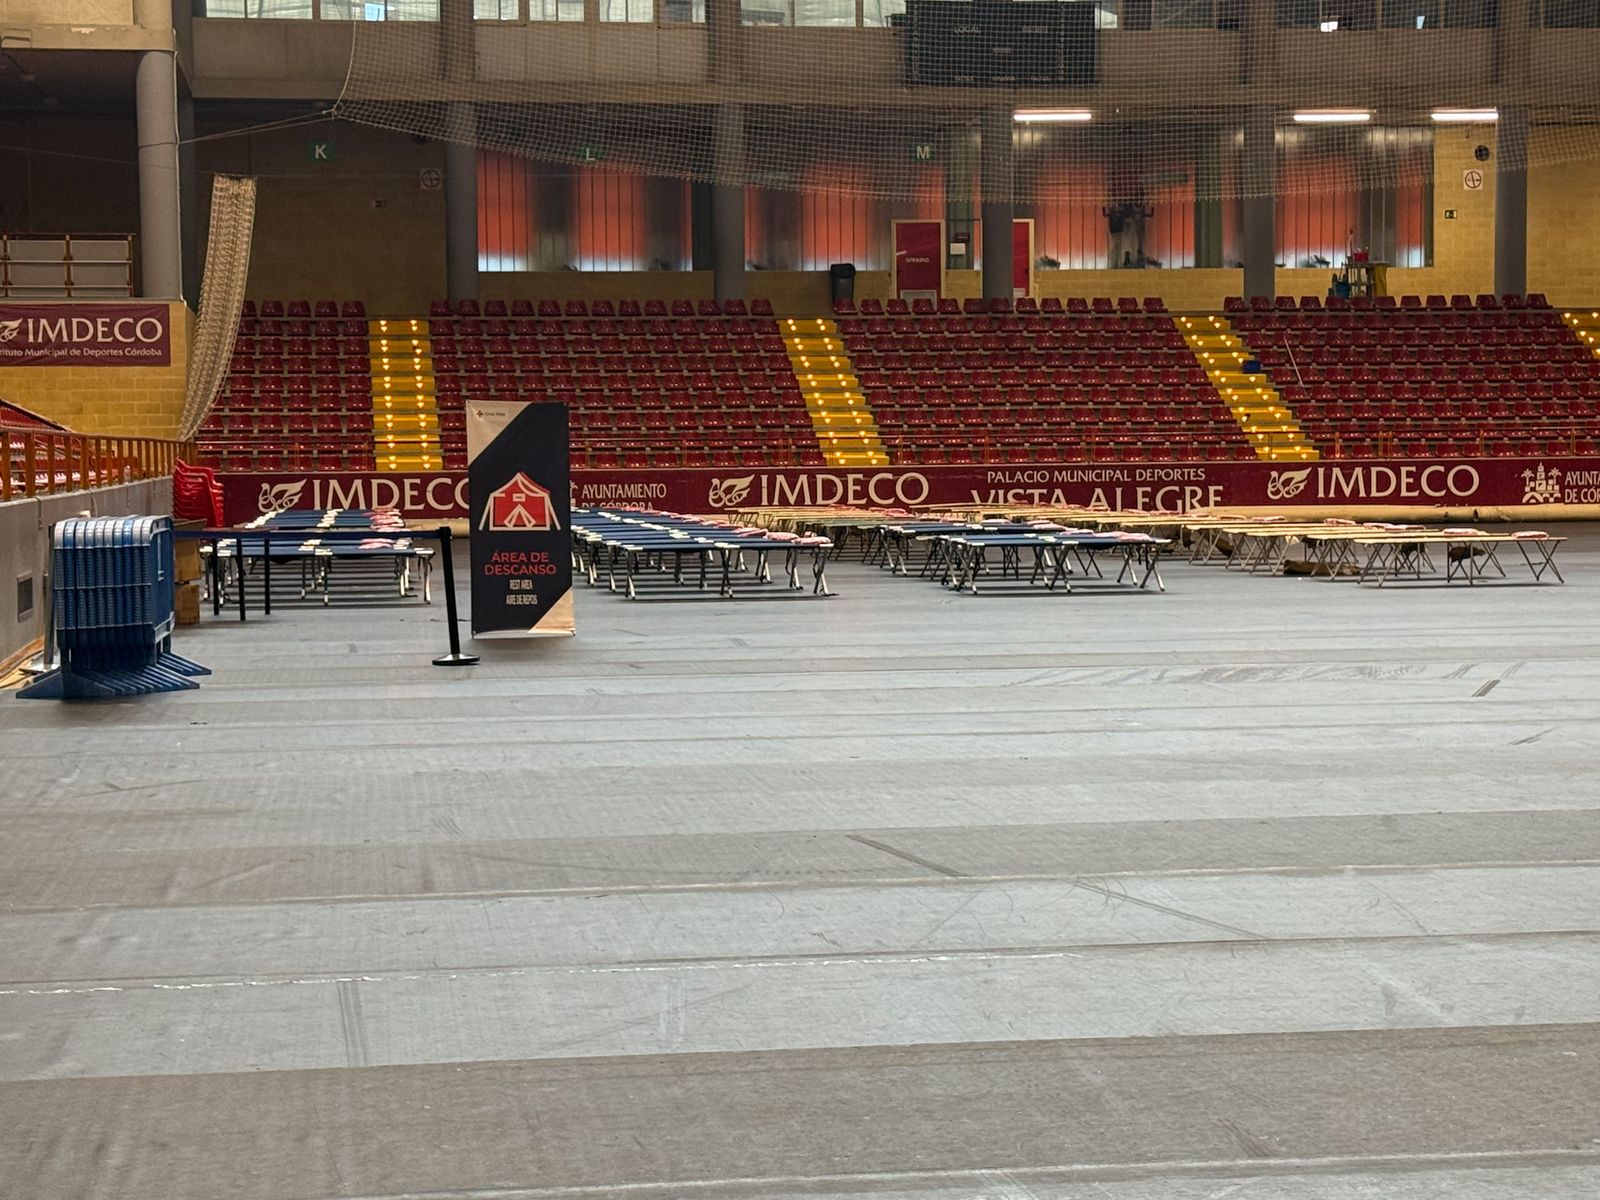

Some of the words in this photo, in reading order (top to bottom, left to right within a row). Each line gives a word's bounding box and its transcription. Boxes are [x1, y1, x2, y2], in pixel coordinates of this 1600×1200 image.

[315, 144, 327, 159] K
[586, 147, 596, 160] L
[916, 145, 929, 159] M
[27, 317, 163, 343] IMDECO
[25, 347, 68, 358] Municipal
[70, 347, 81, 356] de
[83, 347, 123, 358] Deportes
[125, 347, 162, 357] Córdoba
[987, 470, 1050, 484] PALACIO
[1053, 469, 1132, 483] MUNICIPAL
[1135, 468, 1206, 482] DEPORTES
[1317, 464, 1480, 498] IMDECO
[582, 483, 667, 499] AYUNTAMIENTO
[760, 472, 929, 506] IMDECO
[1564, 488, 1579, 503] DE
[491, 550, 528, 562] ÁREA
[530, 552, 549, 562] DE
[484, 564, 557, 576] DESCANSO
